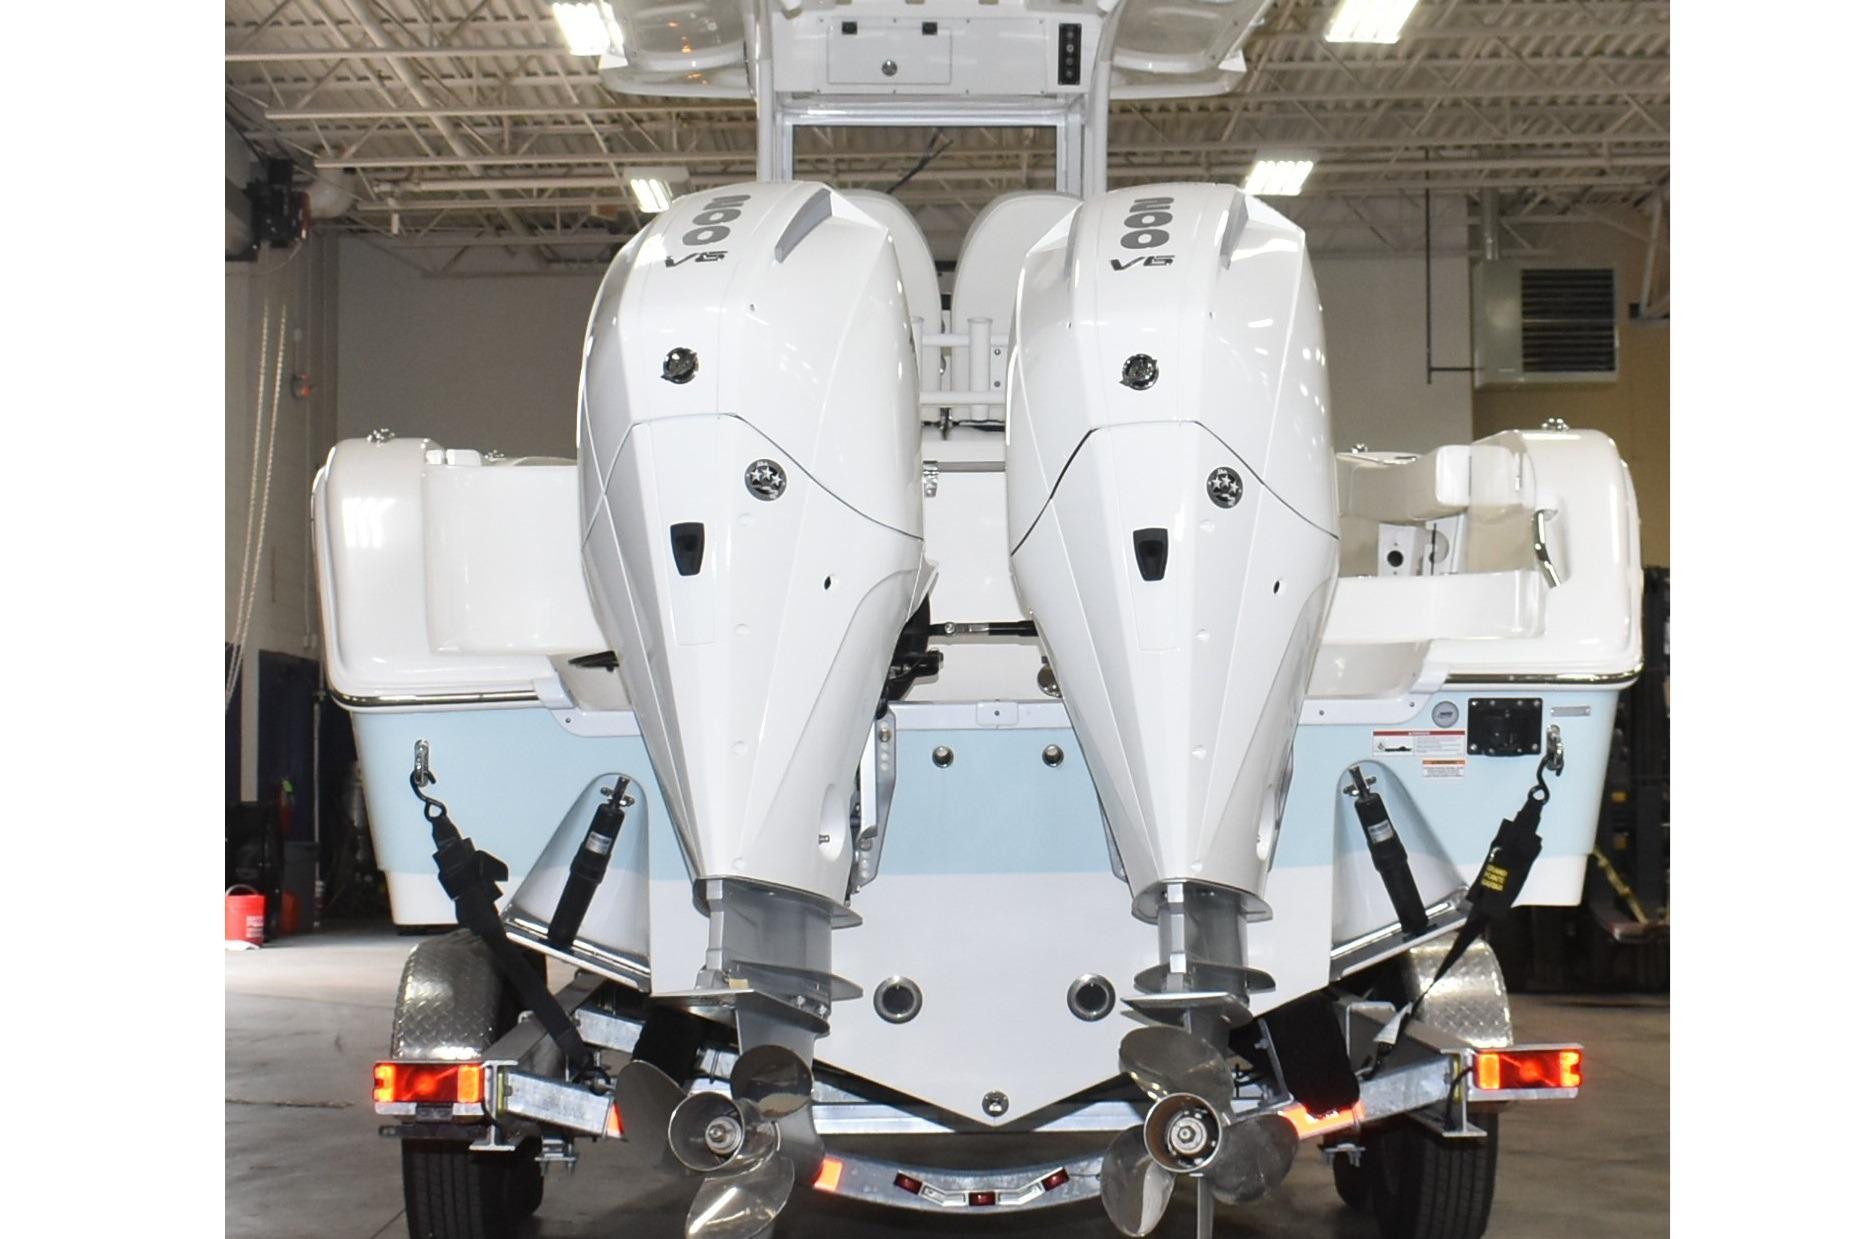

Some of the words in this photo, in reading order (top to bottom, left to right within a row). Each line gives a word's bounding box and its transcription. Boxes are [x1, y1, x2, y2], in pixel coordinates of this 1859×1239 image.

[682, 194, 751, 246] 200
[1120, 197, 1175, 249] 200
[665, 250, 728, 267] V6
[1110, 255, 1175, 271] V6
